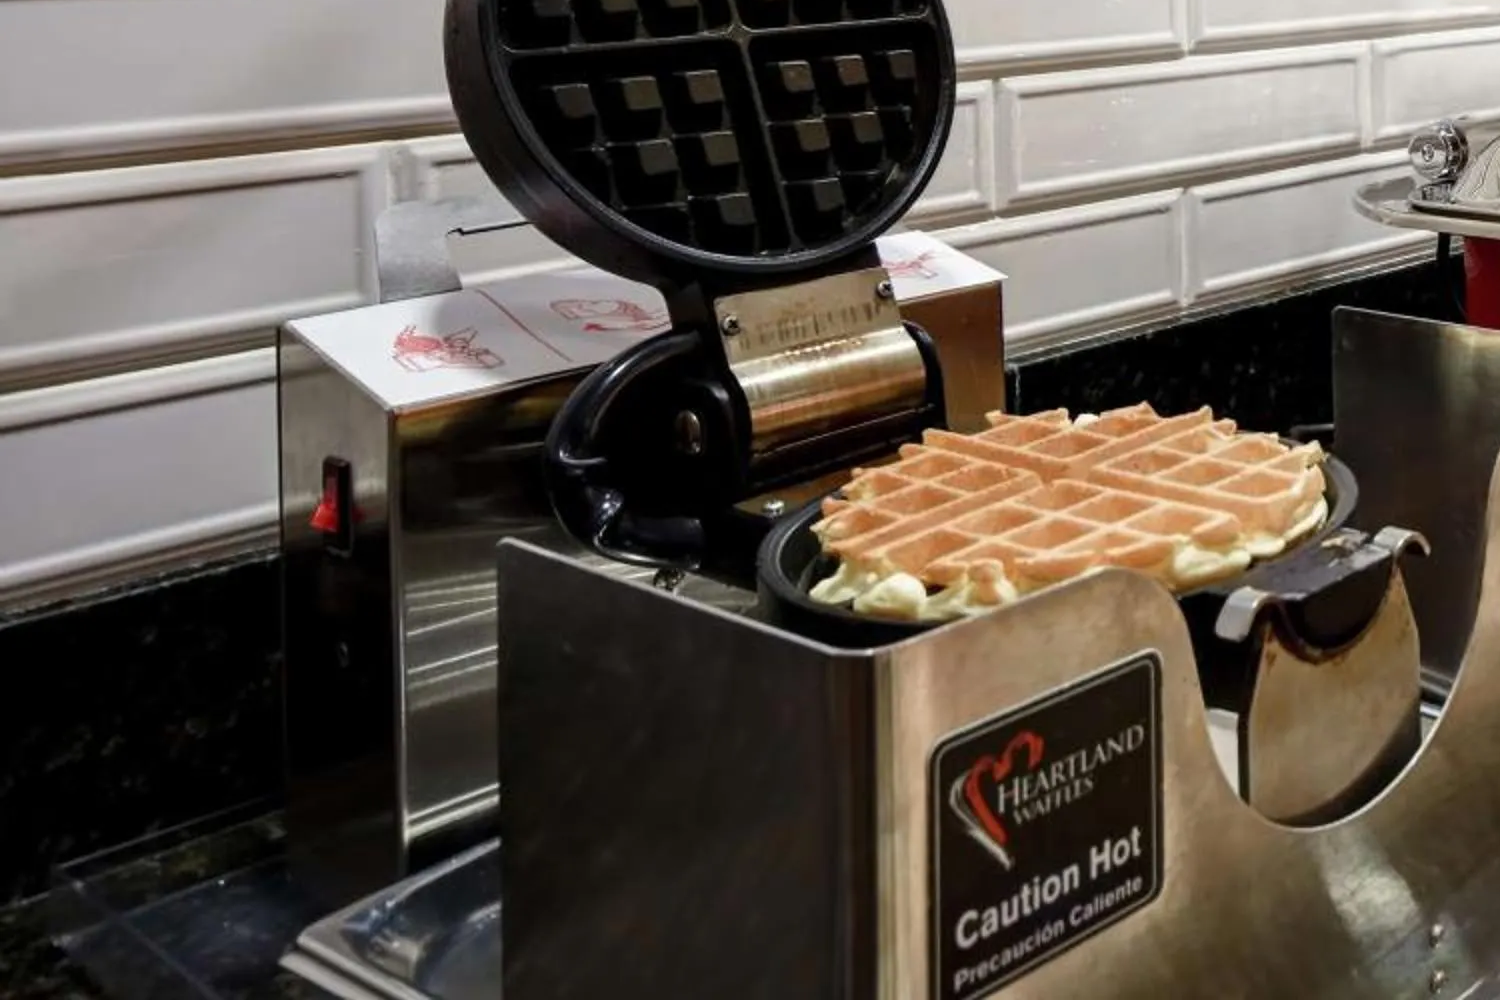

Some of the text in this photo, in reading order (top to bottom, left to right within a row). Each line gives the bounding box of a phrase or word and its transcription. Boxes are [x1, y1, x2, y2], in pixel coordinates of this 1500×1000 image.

[997, 725, 1145, 814] HEARTLAND
[953, 876, 1143, 992] Precaución Caliente
[955, 825, 1142, 949] Caution Hot
